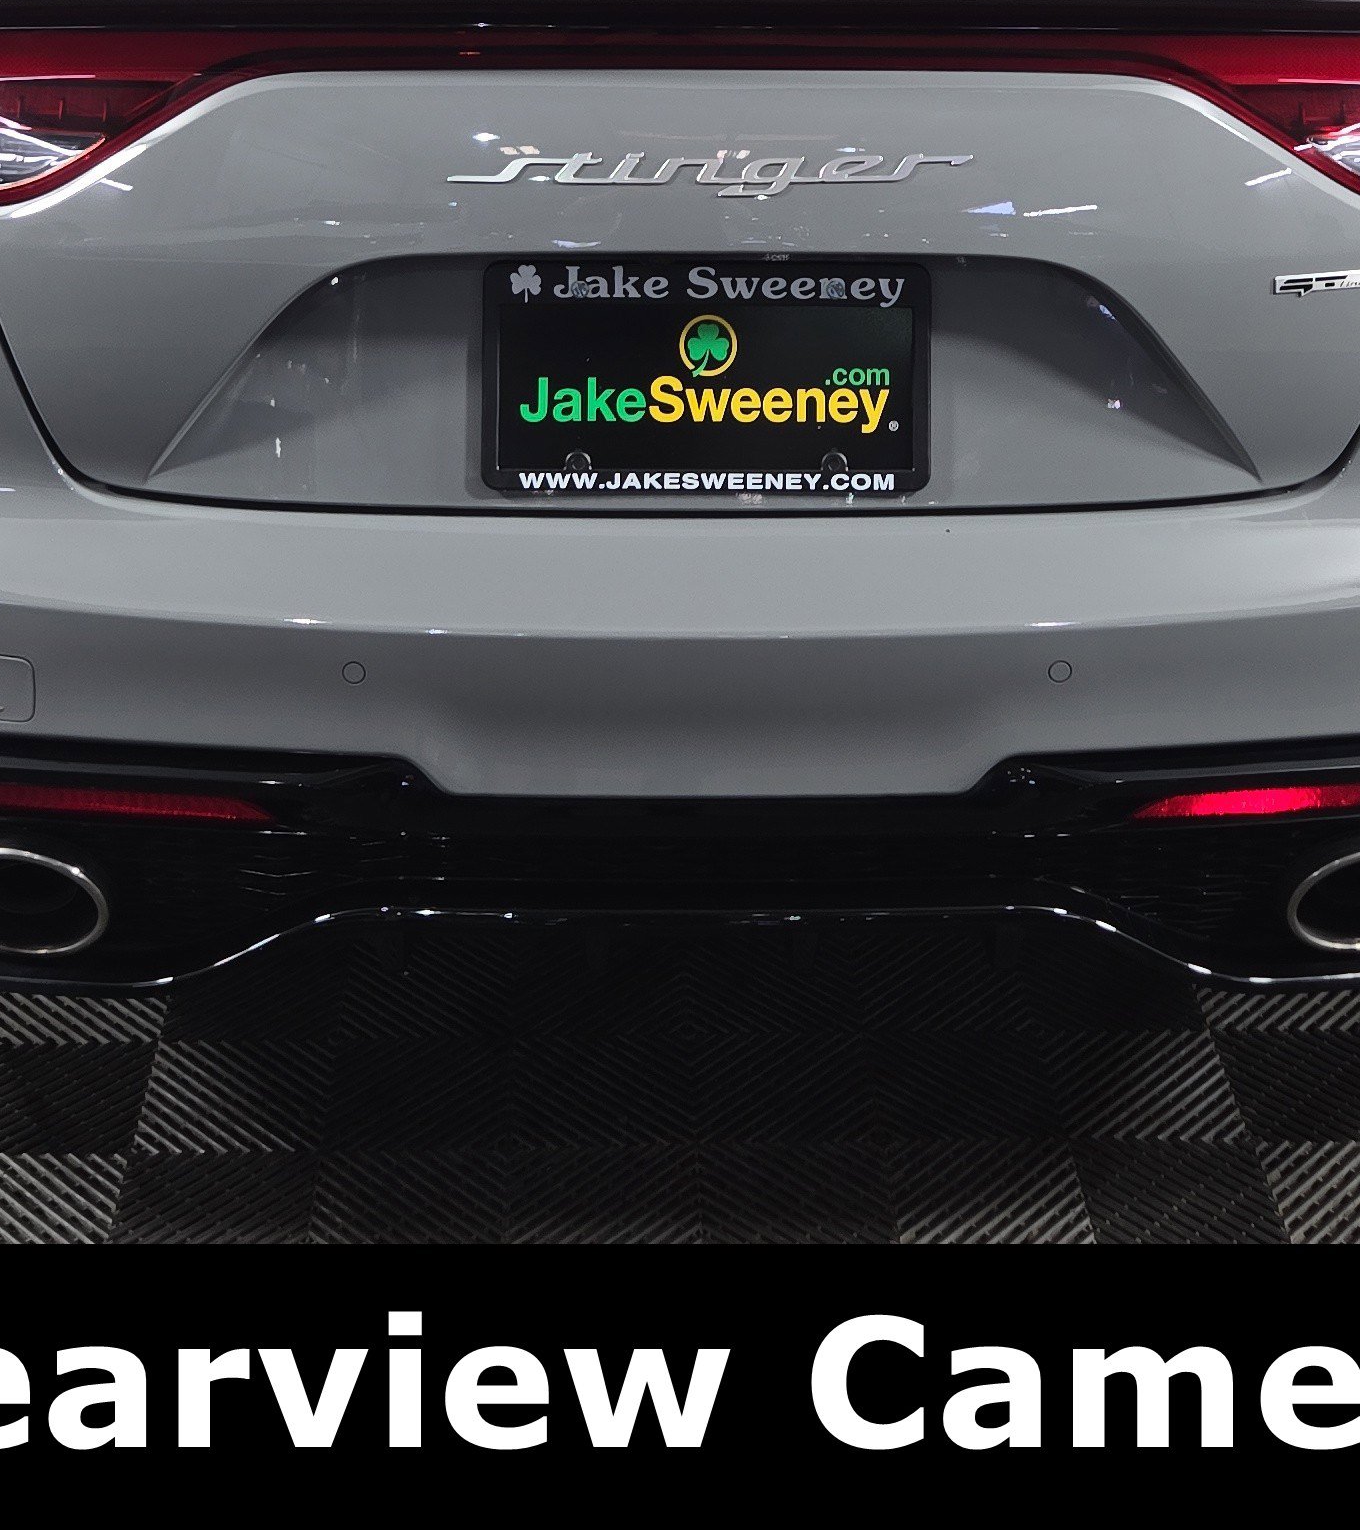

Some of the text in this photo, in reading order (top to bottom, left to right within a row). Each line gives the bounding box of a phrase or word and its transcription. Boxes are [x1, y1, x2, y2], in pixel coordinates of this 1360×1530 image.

[554, 267, 905, 308] Jake Sweeney
[825, 367, 890, 386] .com
[519, 473, 895, 491] WWW.JAKESWEENEY.COM
